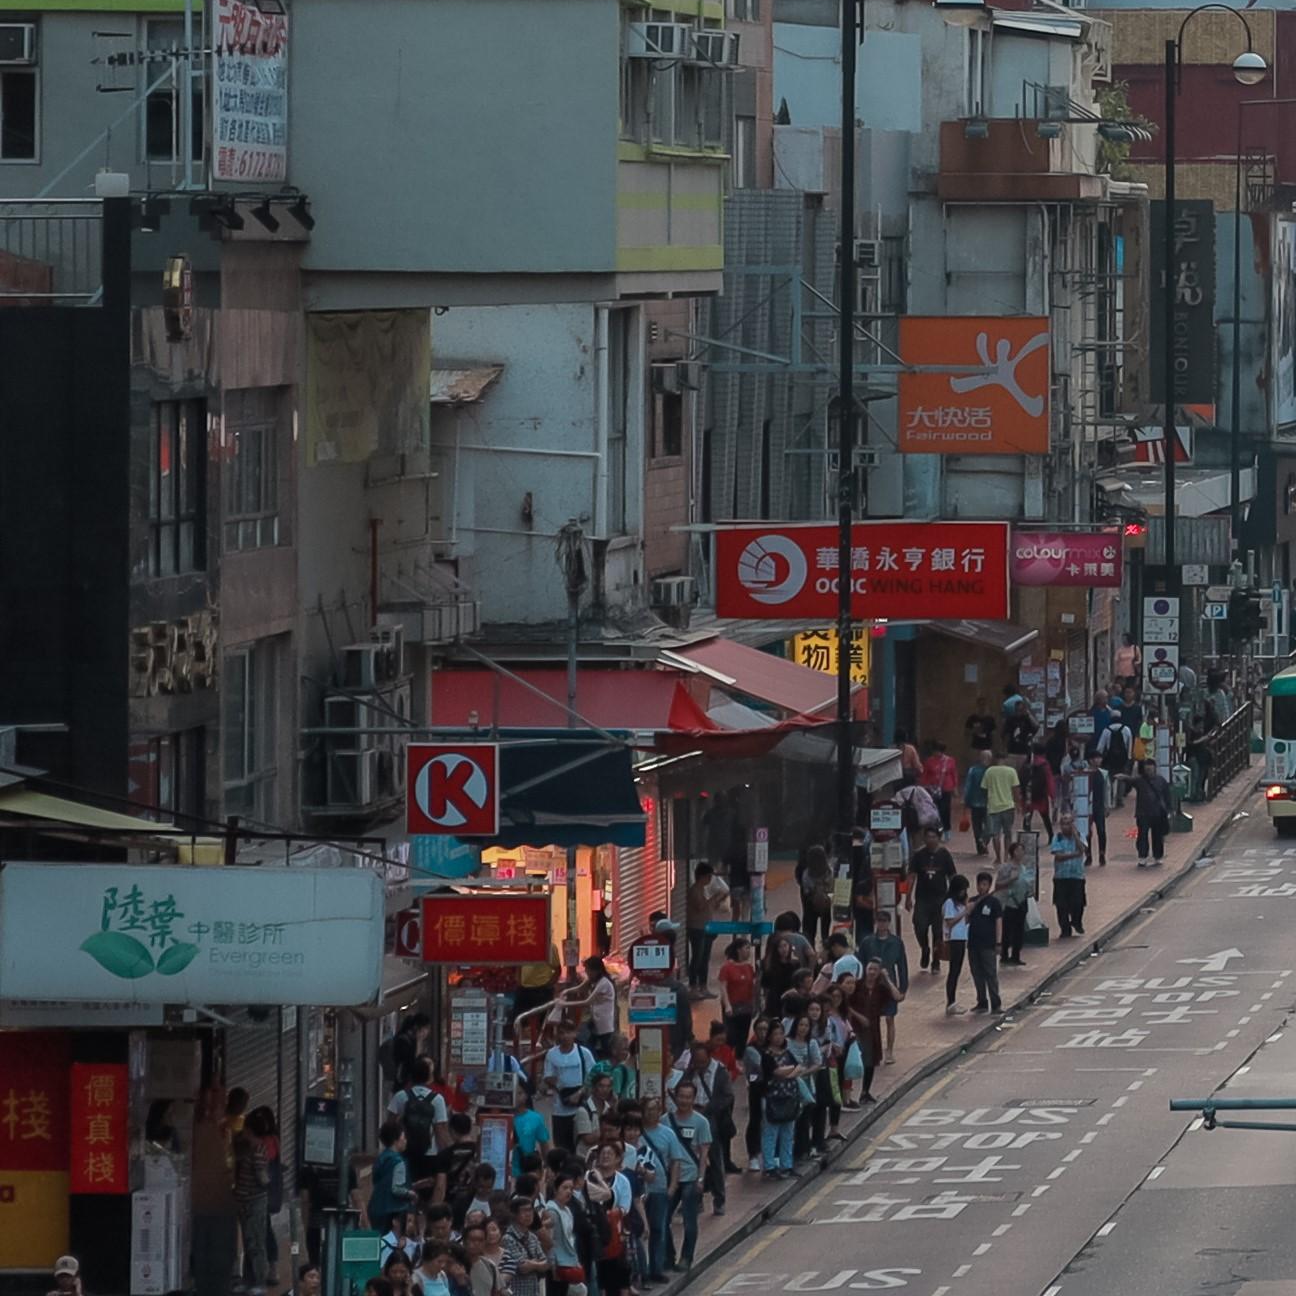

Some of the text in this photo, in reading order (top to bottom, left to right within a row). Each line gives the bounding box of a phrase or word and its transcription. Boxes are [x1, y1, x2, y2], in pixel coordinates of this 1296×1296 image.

[906, 406, 993, 428] 大快活
[906, 430, 993, 441] Fairwood
[816, 546, 985, 573] 華僑永亨銀行
[871, 578, 922, 595] WING
[928, 578, 985, 595] HANG
[427, 759, 475, 819] K
[101, 884, 185, 948] 陸葉
[187, 920, 286, 945] 中醫診所
[209, 948, 305, 967] Evergreen
[1094, 976, 1239, 991] BUS
[1067, 990, 1241, 1005] STOP
[1039, 1006, 1219, 1028] 巴士
[1055, 1028, 1151, 1049] 站
[903, 1107, 1078, 1126] BUS
[876, 1131, 1063, 1151] STOP
[837, 1156, 1022, 1187] 巴士
[812, 1190, 970, 1224] 站
